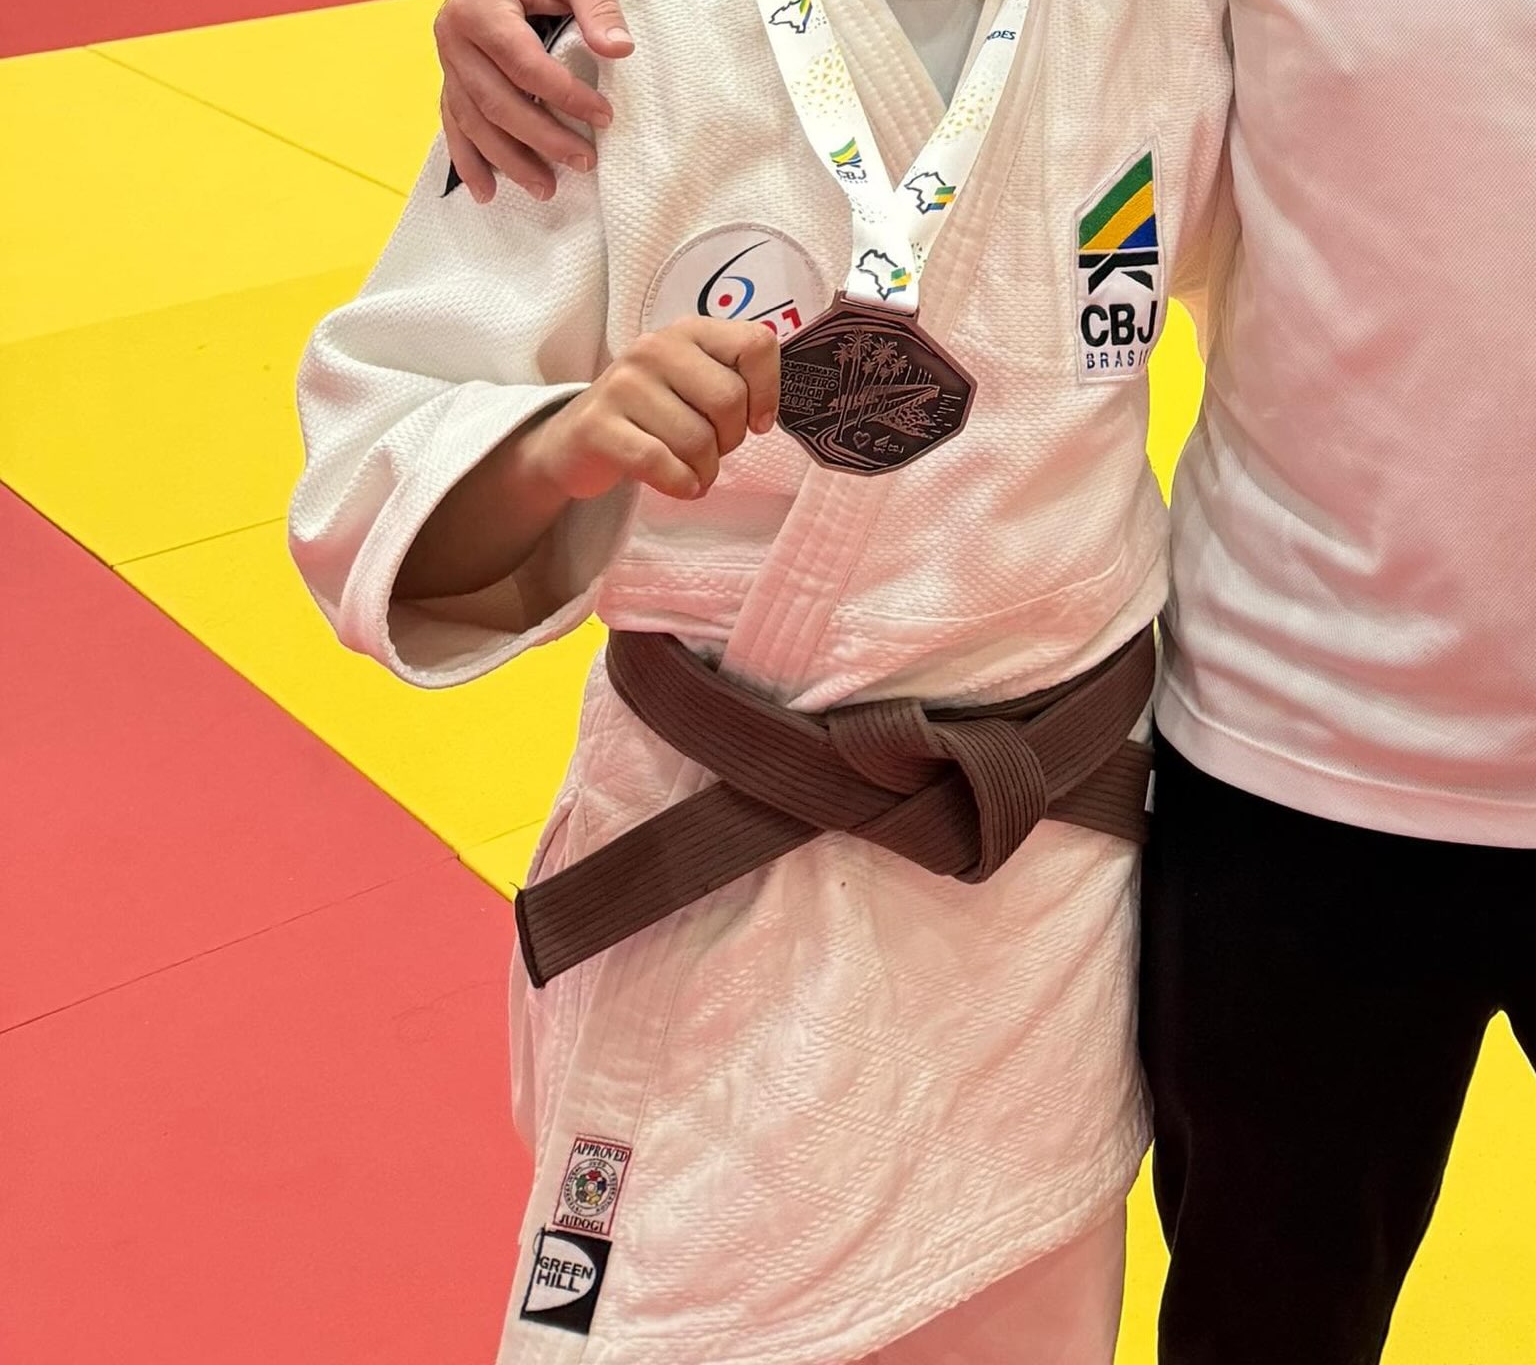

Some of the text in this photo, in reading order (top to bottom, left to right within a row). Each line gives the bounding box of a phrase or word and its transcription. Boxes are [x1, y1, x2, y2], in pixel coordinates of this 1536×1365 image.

[1080, 300, 1158, 347] CBJ
[574, 1142, 629, 1163] APPROVED
[559, 1213, 605, 1234] JUDOGI
[538, 1255, 594, 1281] GREEN
[536, 1269, 580, 1293] HILL
